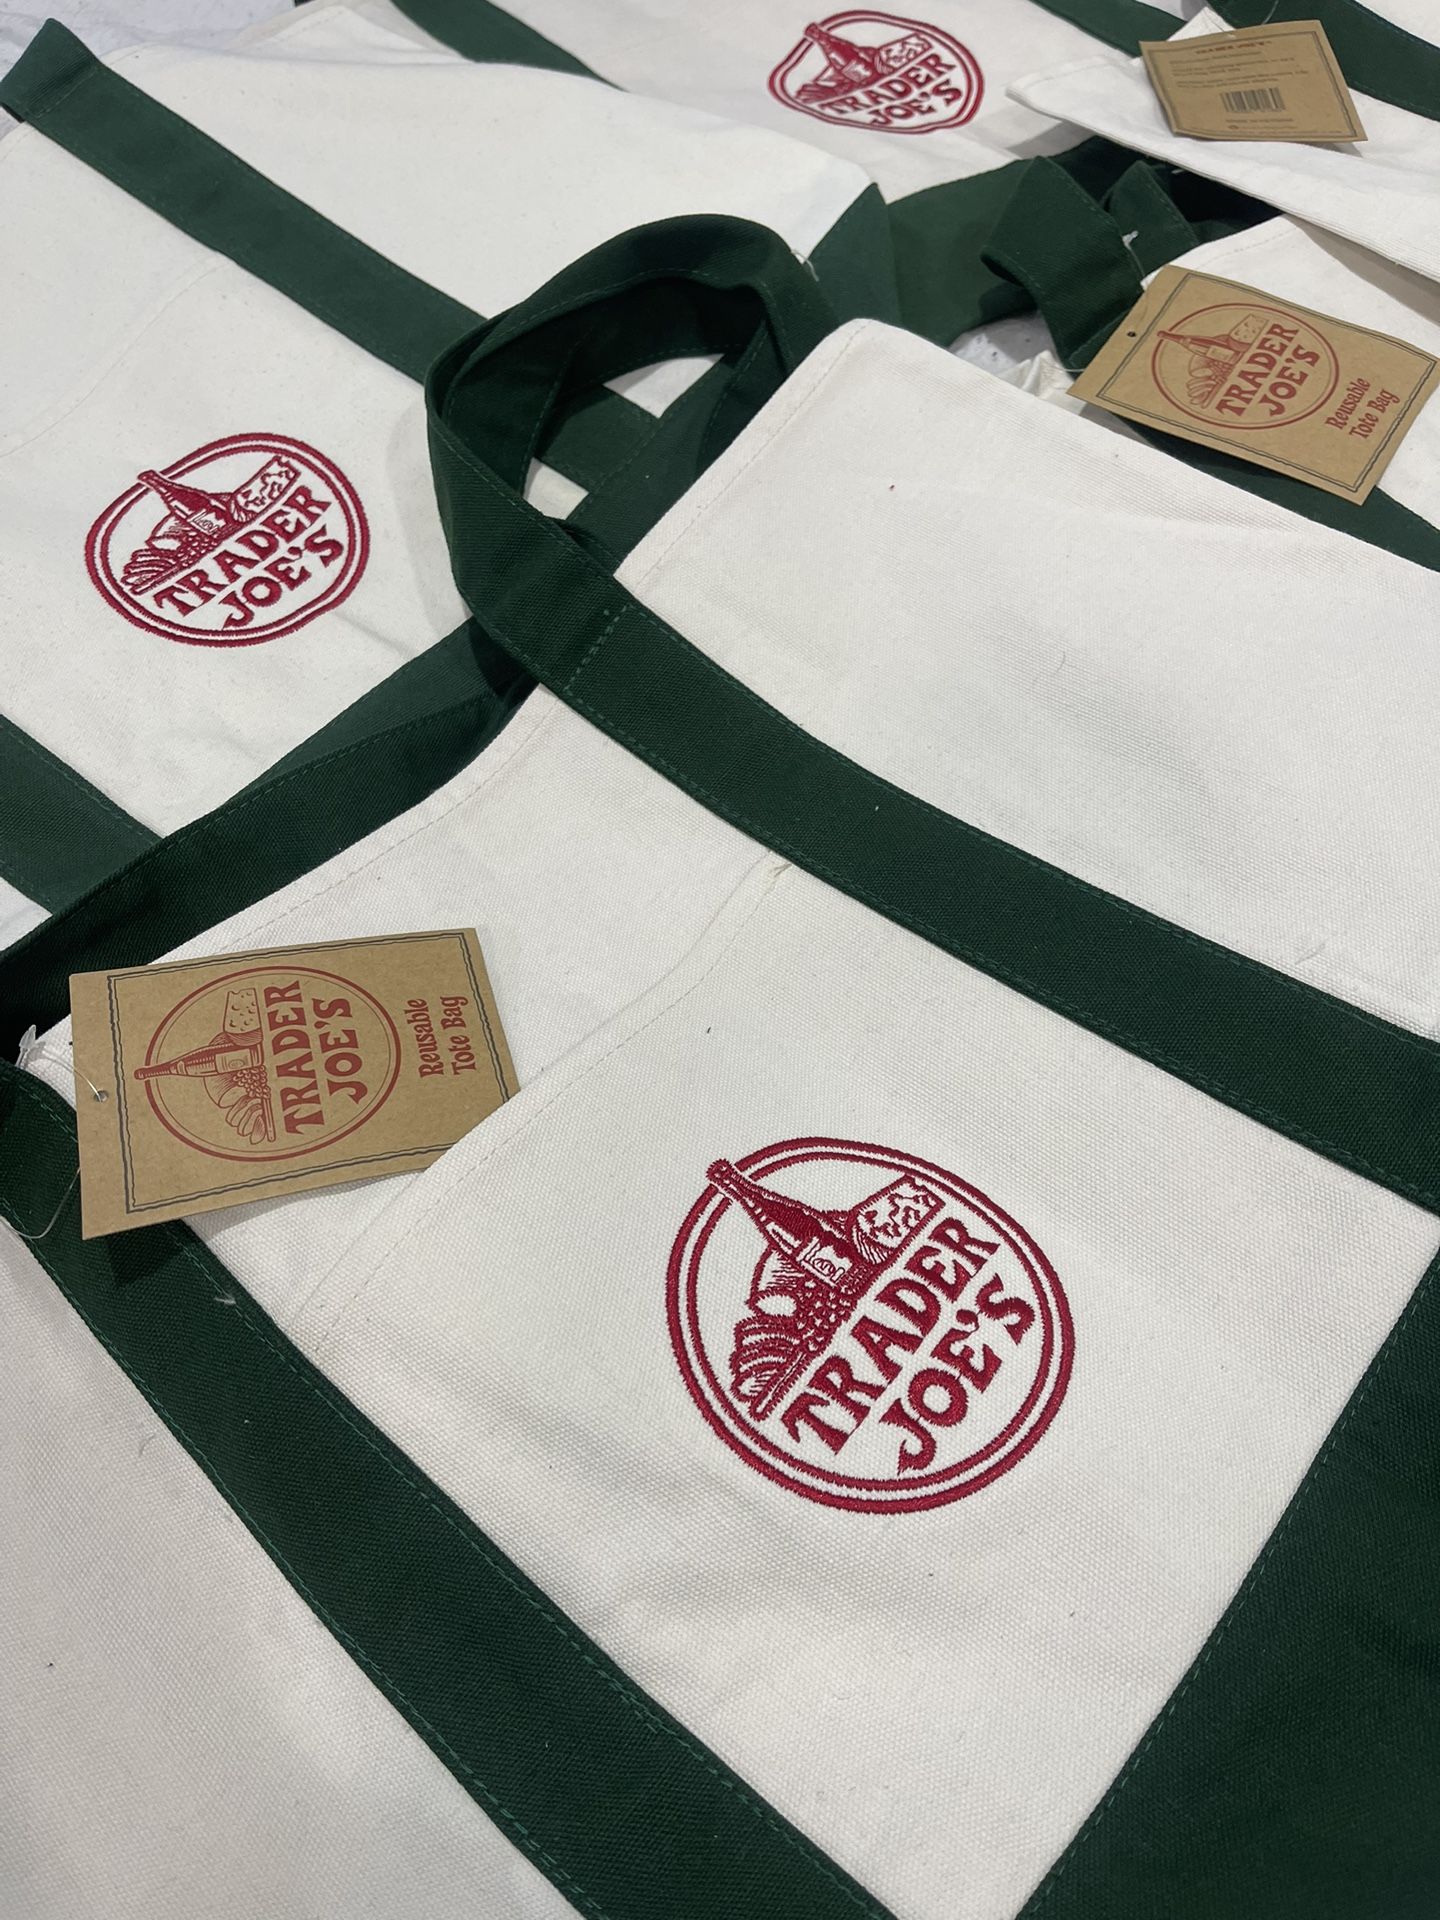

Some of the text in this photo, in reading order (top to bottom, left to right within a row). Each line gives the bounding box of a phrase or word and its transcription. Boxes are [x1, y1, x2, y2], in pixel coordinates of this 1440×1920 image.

[820, 53, 956, 114] TRADER
[868, 78, 963, 126] JOE'S
[1215, 323, 1299, 417] TRADER
[1257, 344, 1321, 417] JOE'S
[1324, 377, 1371, 430] Reusable
[1348, 388, 1401, 439] Tote Bag
[153, 485, 332, 617] TRADER
[218, 525, 345, 630] JOE'S
[263, 980, 326, 1135] TRADER
[312, 997, 368, 1104] JOE'S
[403, 998, 445, 1078] Reusable
[439, 995, 477, 1076] Tote Bag
[780, 1217, 1001, 1455] TRADER
[878, 1272, 1036, 1476] JOE'S
